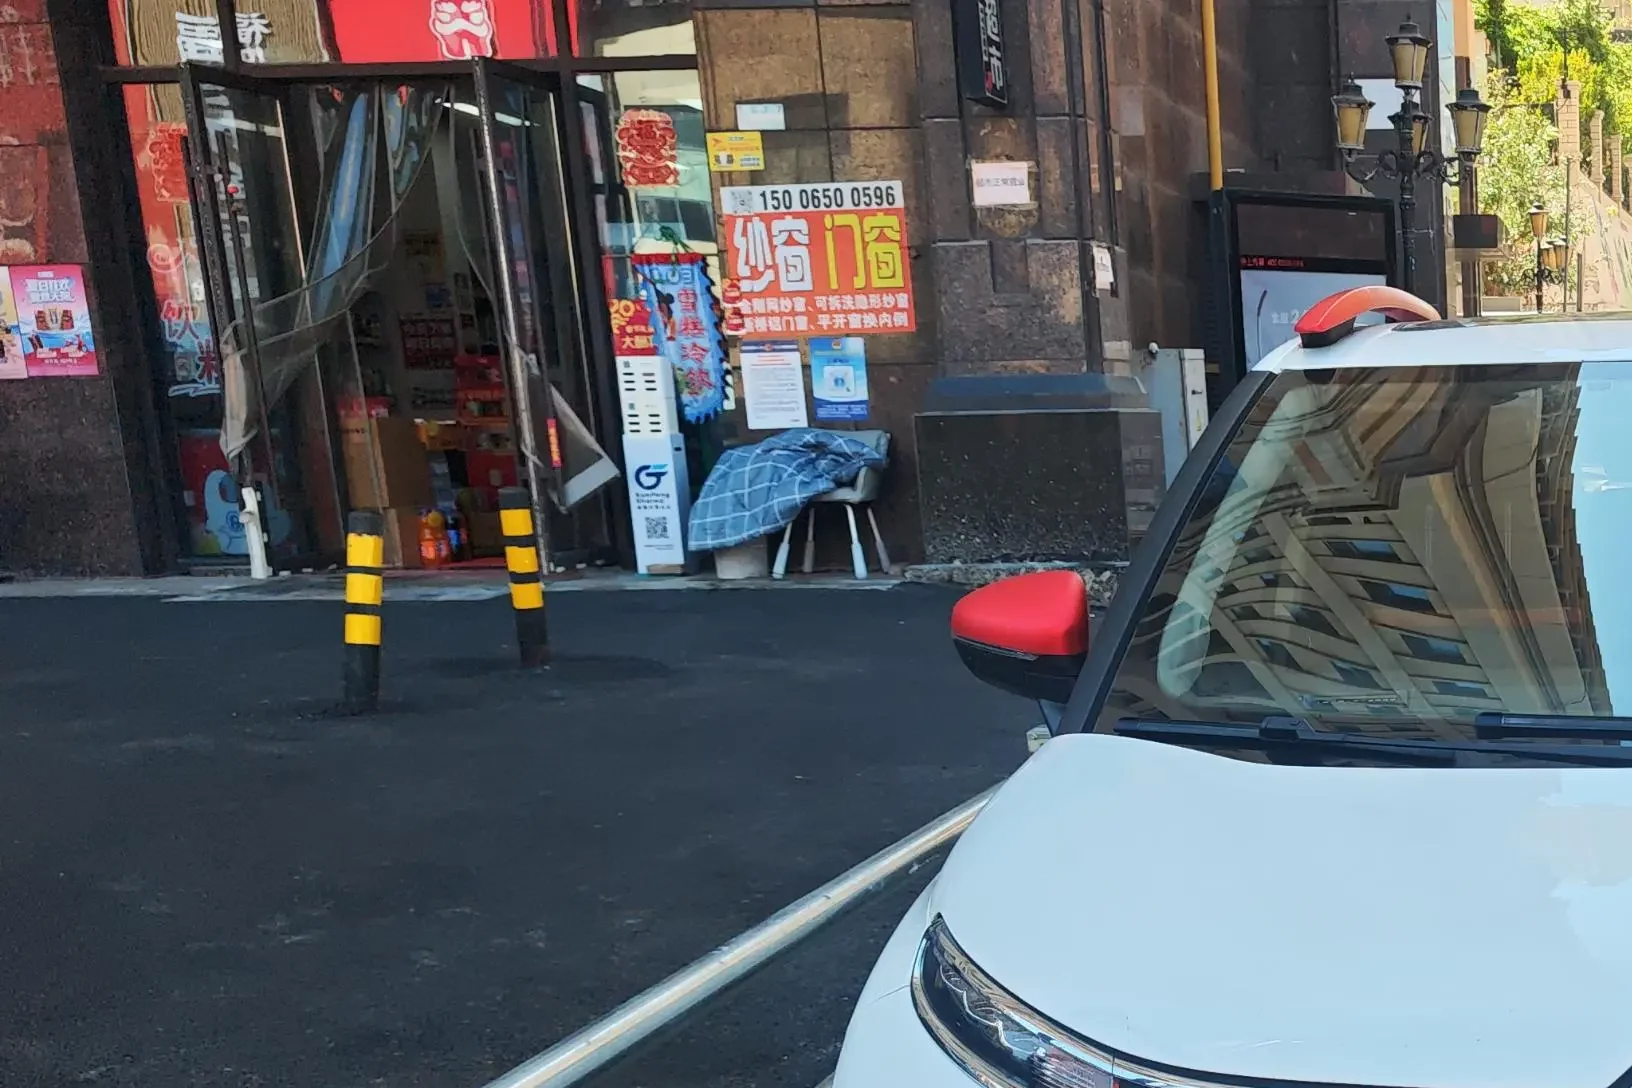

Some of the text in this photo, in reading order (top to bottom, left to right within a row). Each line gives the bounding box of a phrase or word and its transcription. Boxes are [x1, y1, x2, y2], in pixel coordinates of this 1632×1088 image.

[759, 185, 896, 210] 150 0650 0596
[733, 212, 905, 292] 纱窗 门窗
